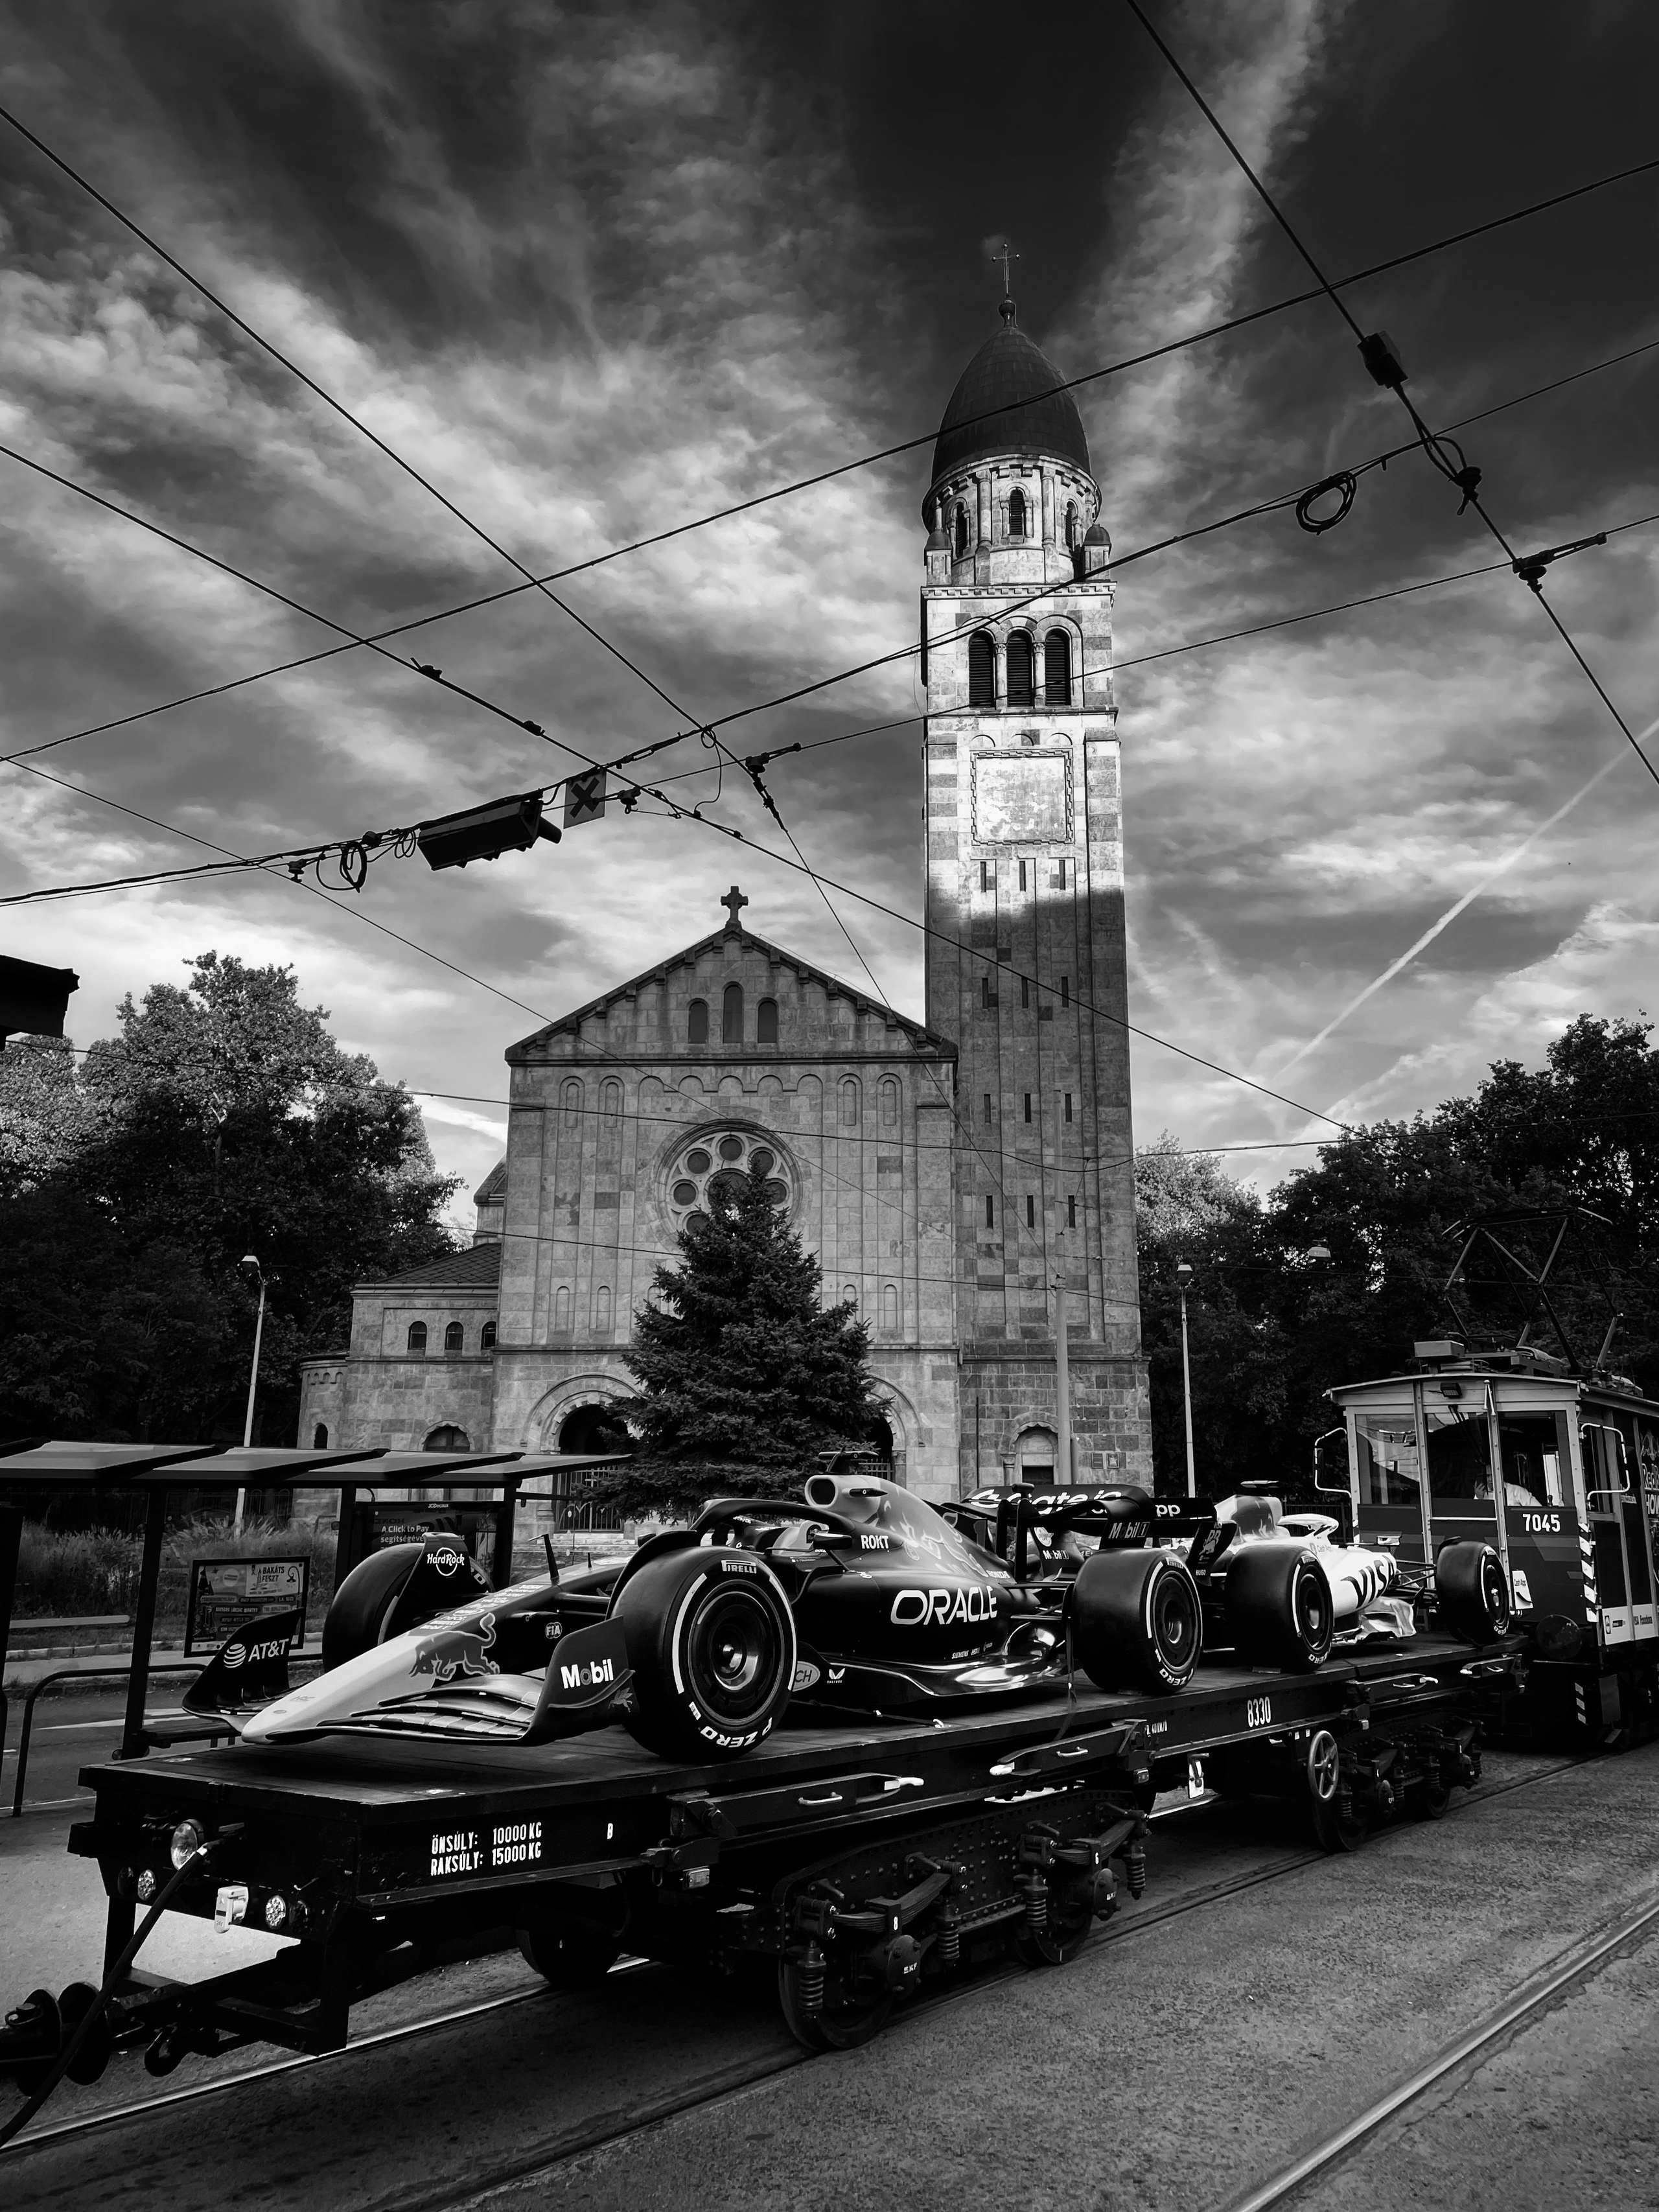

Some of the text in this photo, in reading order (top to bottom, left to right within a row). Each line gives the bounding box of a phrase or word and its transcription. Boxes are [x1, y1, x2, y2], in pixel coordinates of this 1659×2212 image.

[416, 1526, 430, 1536] Pay
[1108, 1522, 1139, 1540] Mobil
[1523, 1514, 1560, 1532] 7045
[380, 1534, 424, 1544] segítségéve
[861, 1535, 889, 1550] ROKT
[262, 1565, 284, 1574] BAKÁTS
[721, 1559, 757, 1574] PIRELLI
[986, 1570, 1011, 1579] HONDA
[1340, 1555, 1395, 1609] VISA
[890, 1585, 998, 1625] ORACLE
[249, 1638, 290, 1663] AT&T
[561, 1659, 614, 1689] Mobil
[1159, 1668, 1187, 1686] ZERO
[1247, 1696, 1271, 1728] 8330
[700, 1717, 772, 1748] P ZERO
[431, 1822, 542, 1855] ÖNSÚLY: 10000 KG
[430, 1841, 542, 1876] RAKSÚLY: 15000 KG
